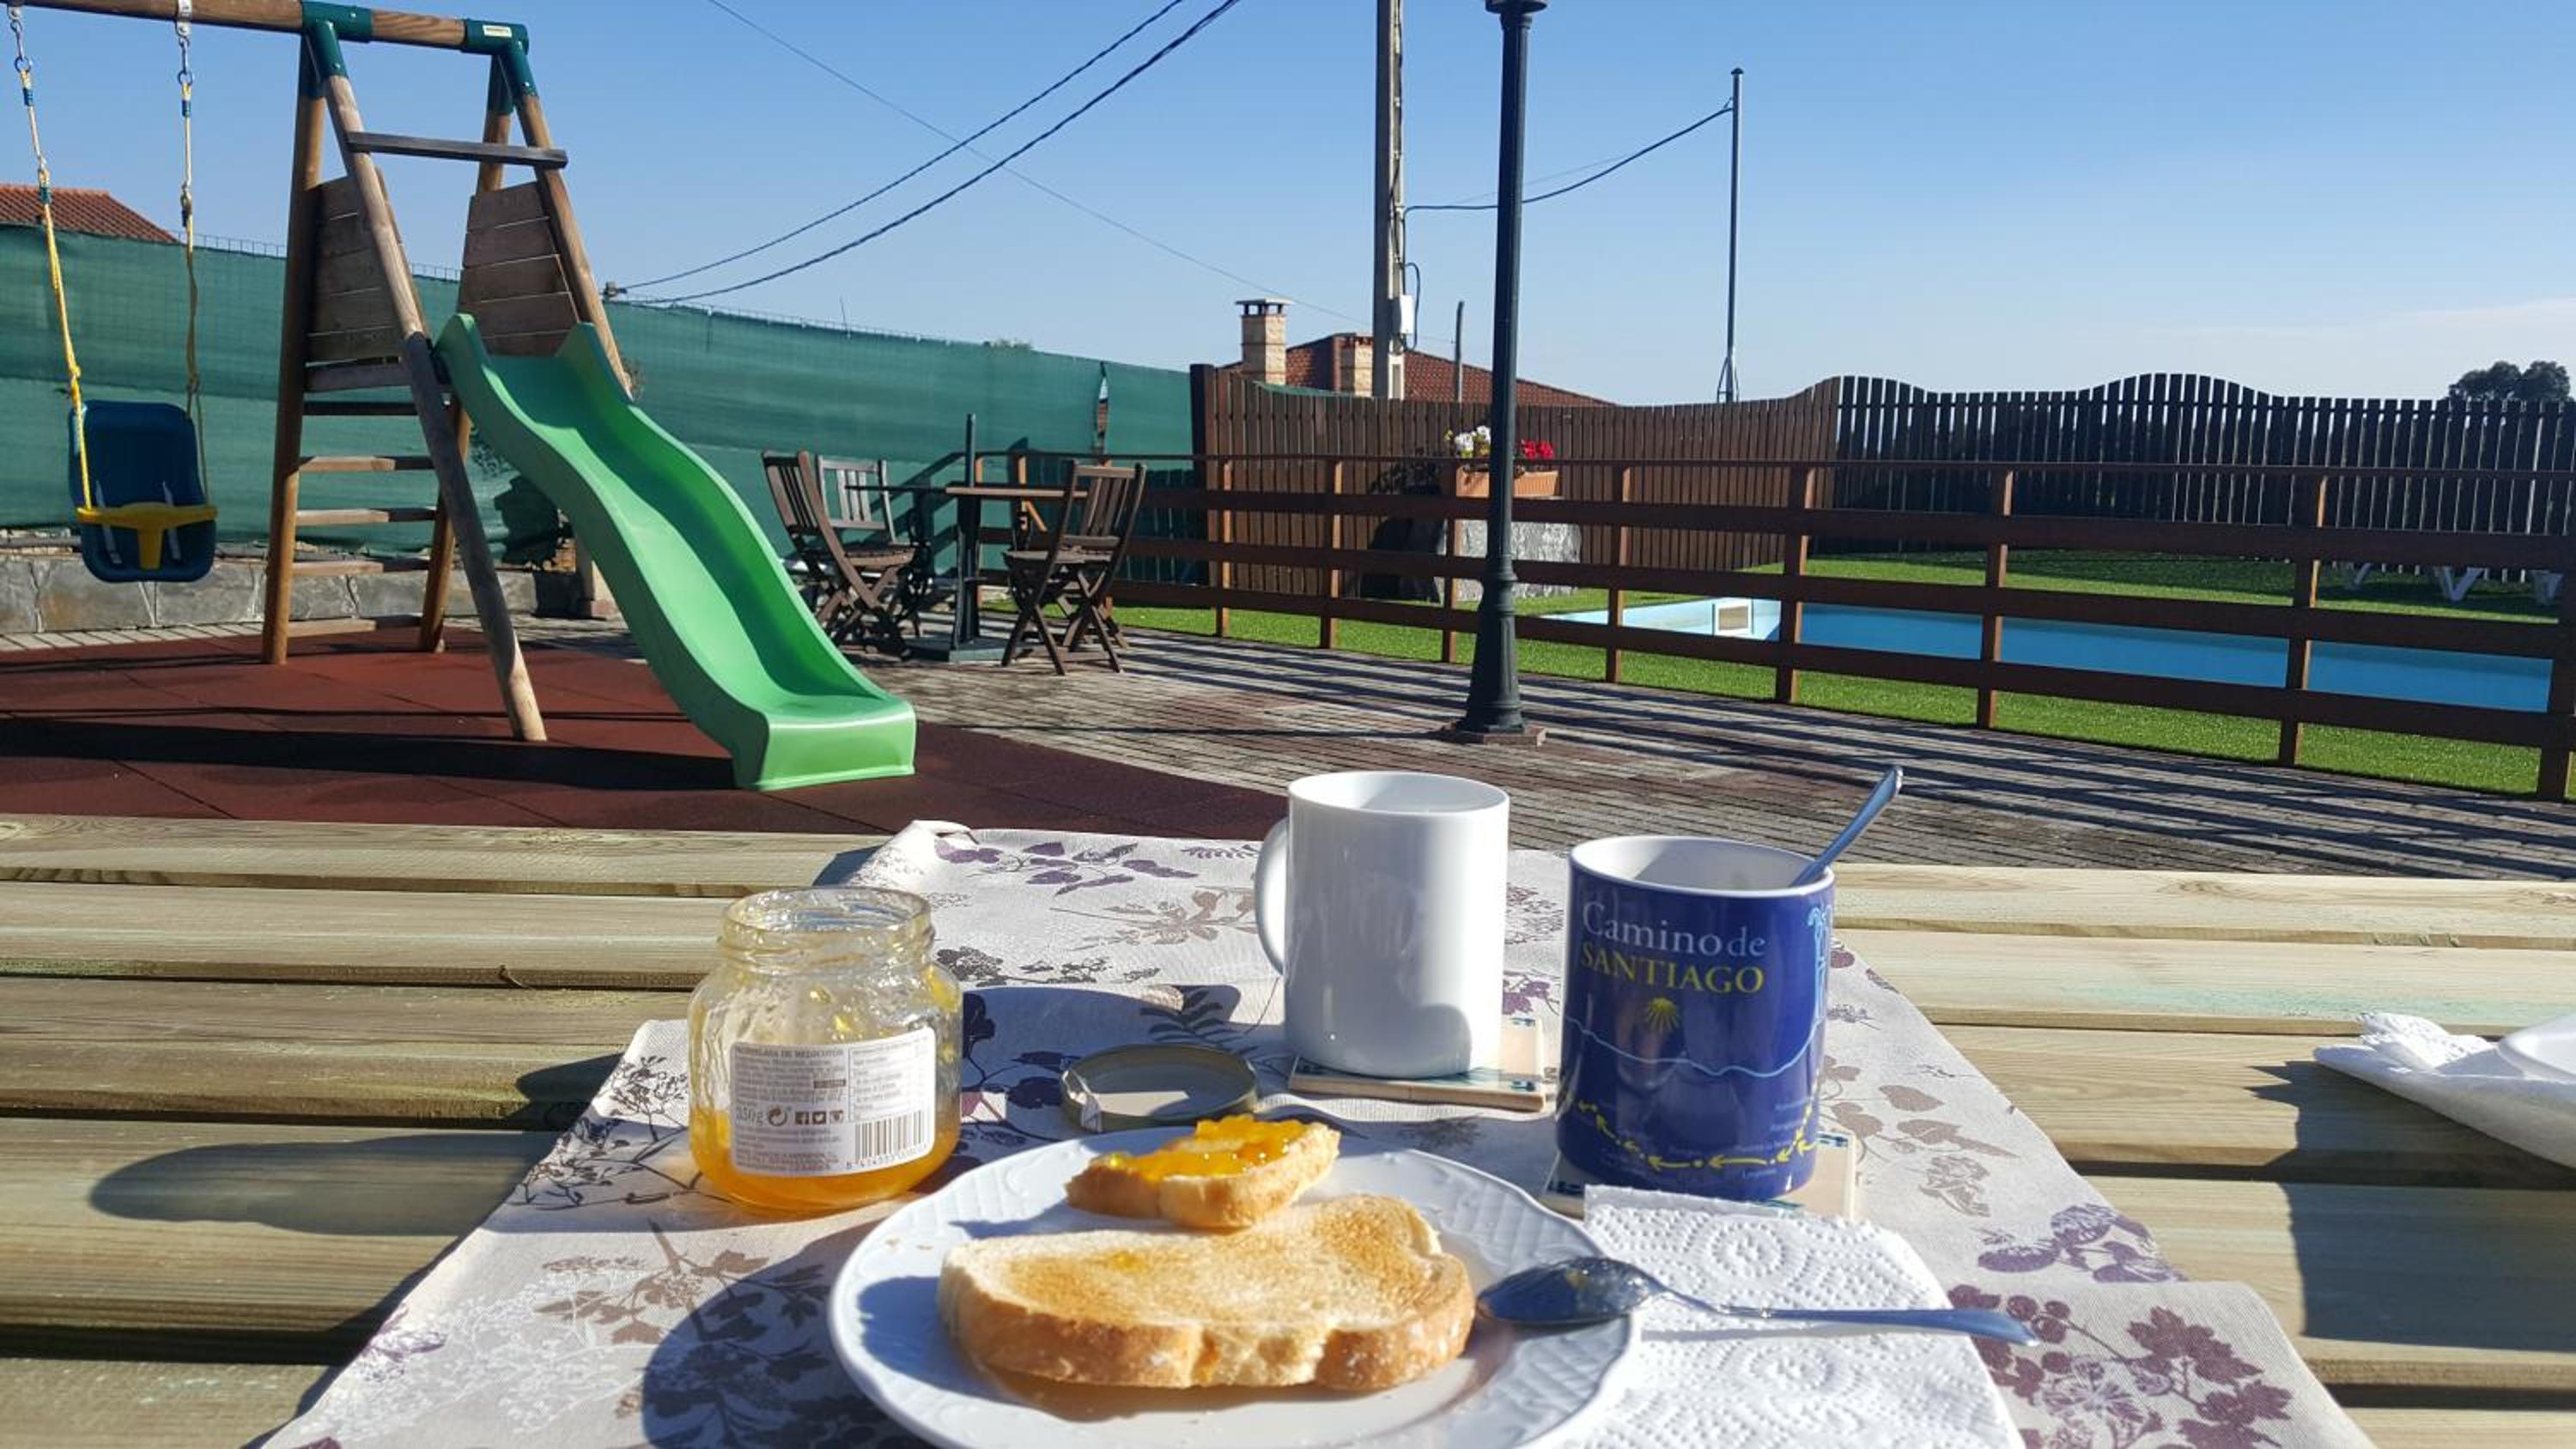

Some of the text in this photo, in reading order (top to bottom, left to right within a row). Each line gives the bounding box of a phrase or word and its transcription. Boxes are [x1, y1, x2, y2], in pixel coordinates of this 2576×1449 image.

[1583, 901, 1765, 956] Camino de
[1581, 941, 1765, 993] SANTIAGO
